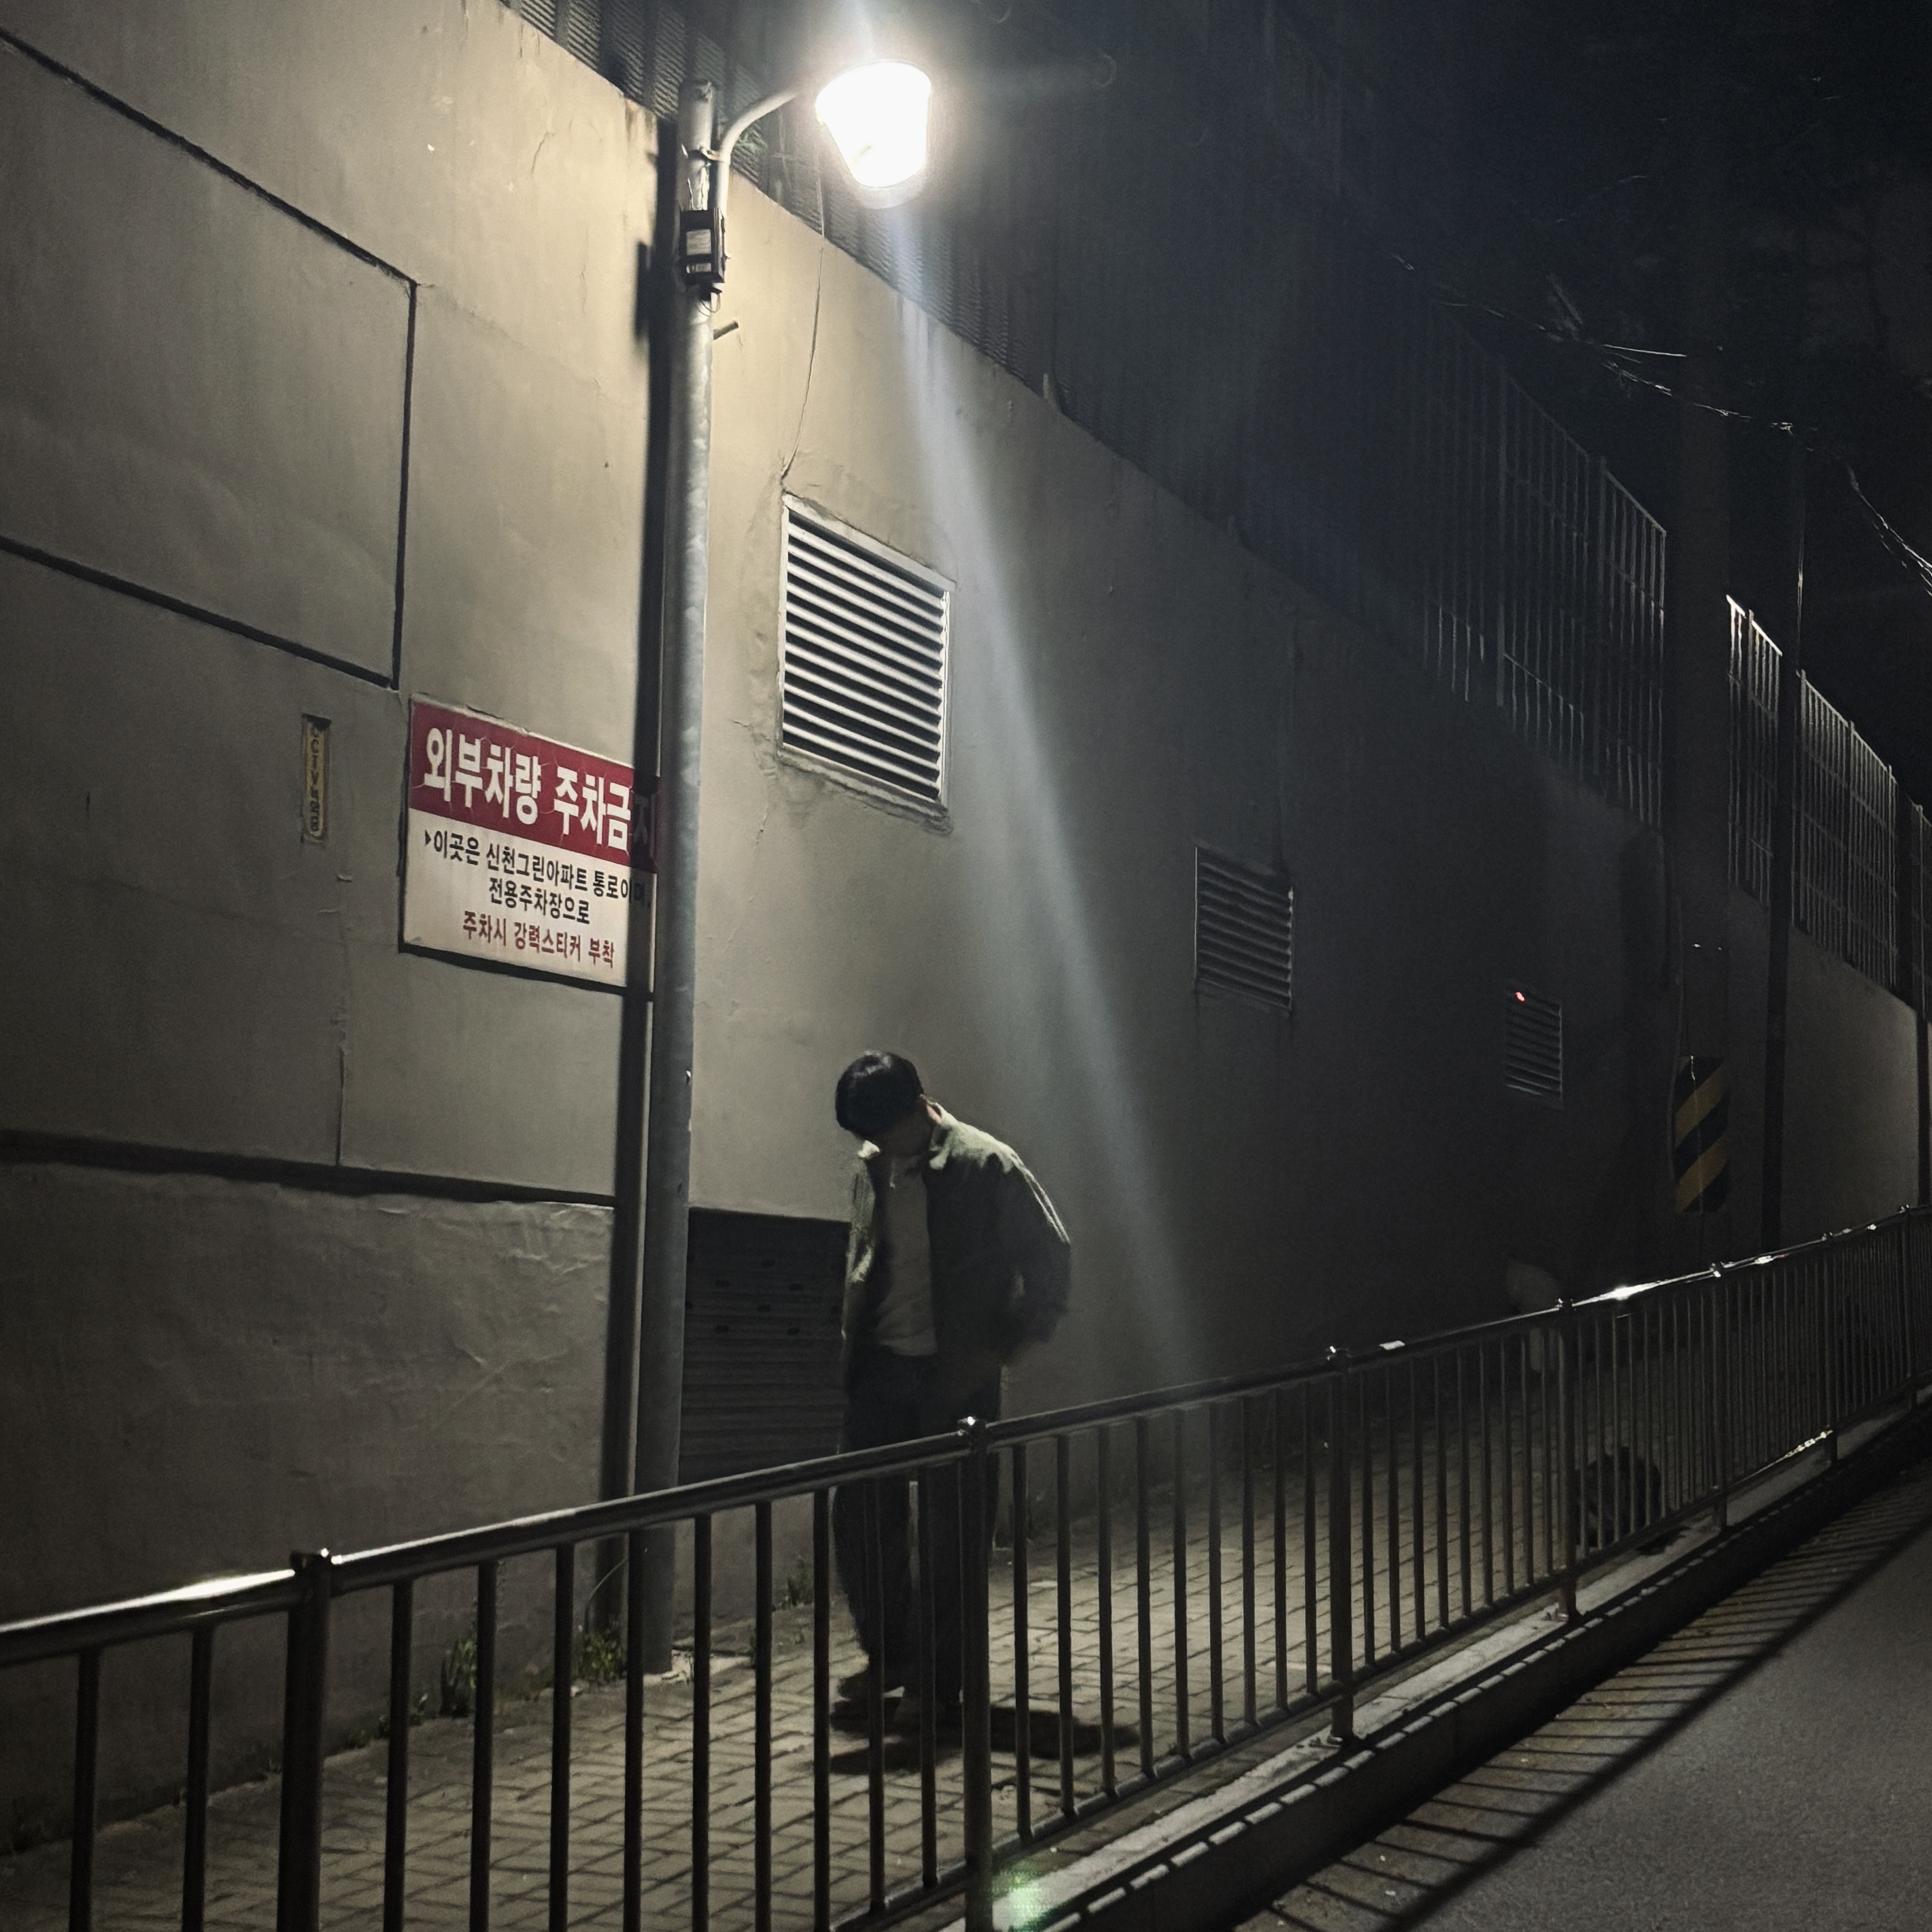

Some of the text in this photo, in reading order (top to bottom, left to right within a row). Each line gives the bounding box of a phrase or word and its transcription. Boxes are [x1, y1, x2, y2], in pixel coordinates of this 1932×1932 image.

[424, 727, 542, 825] 외부차량
[434, 830, 480, 866] 이곳은
[486, 843, 588, 892] 신천그린아파트
[489, 877, 590, 925] 전용주차장으로
[463, 910, 615, 969] 주차시 강력스티커 부착
